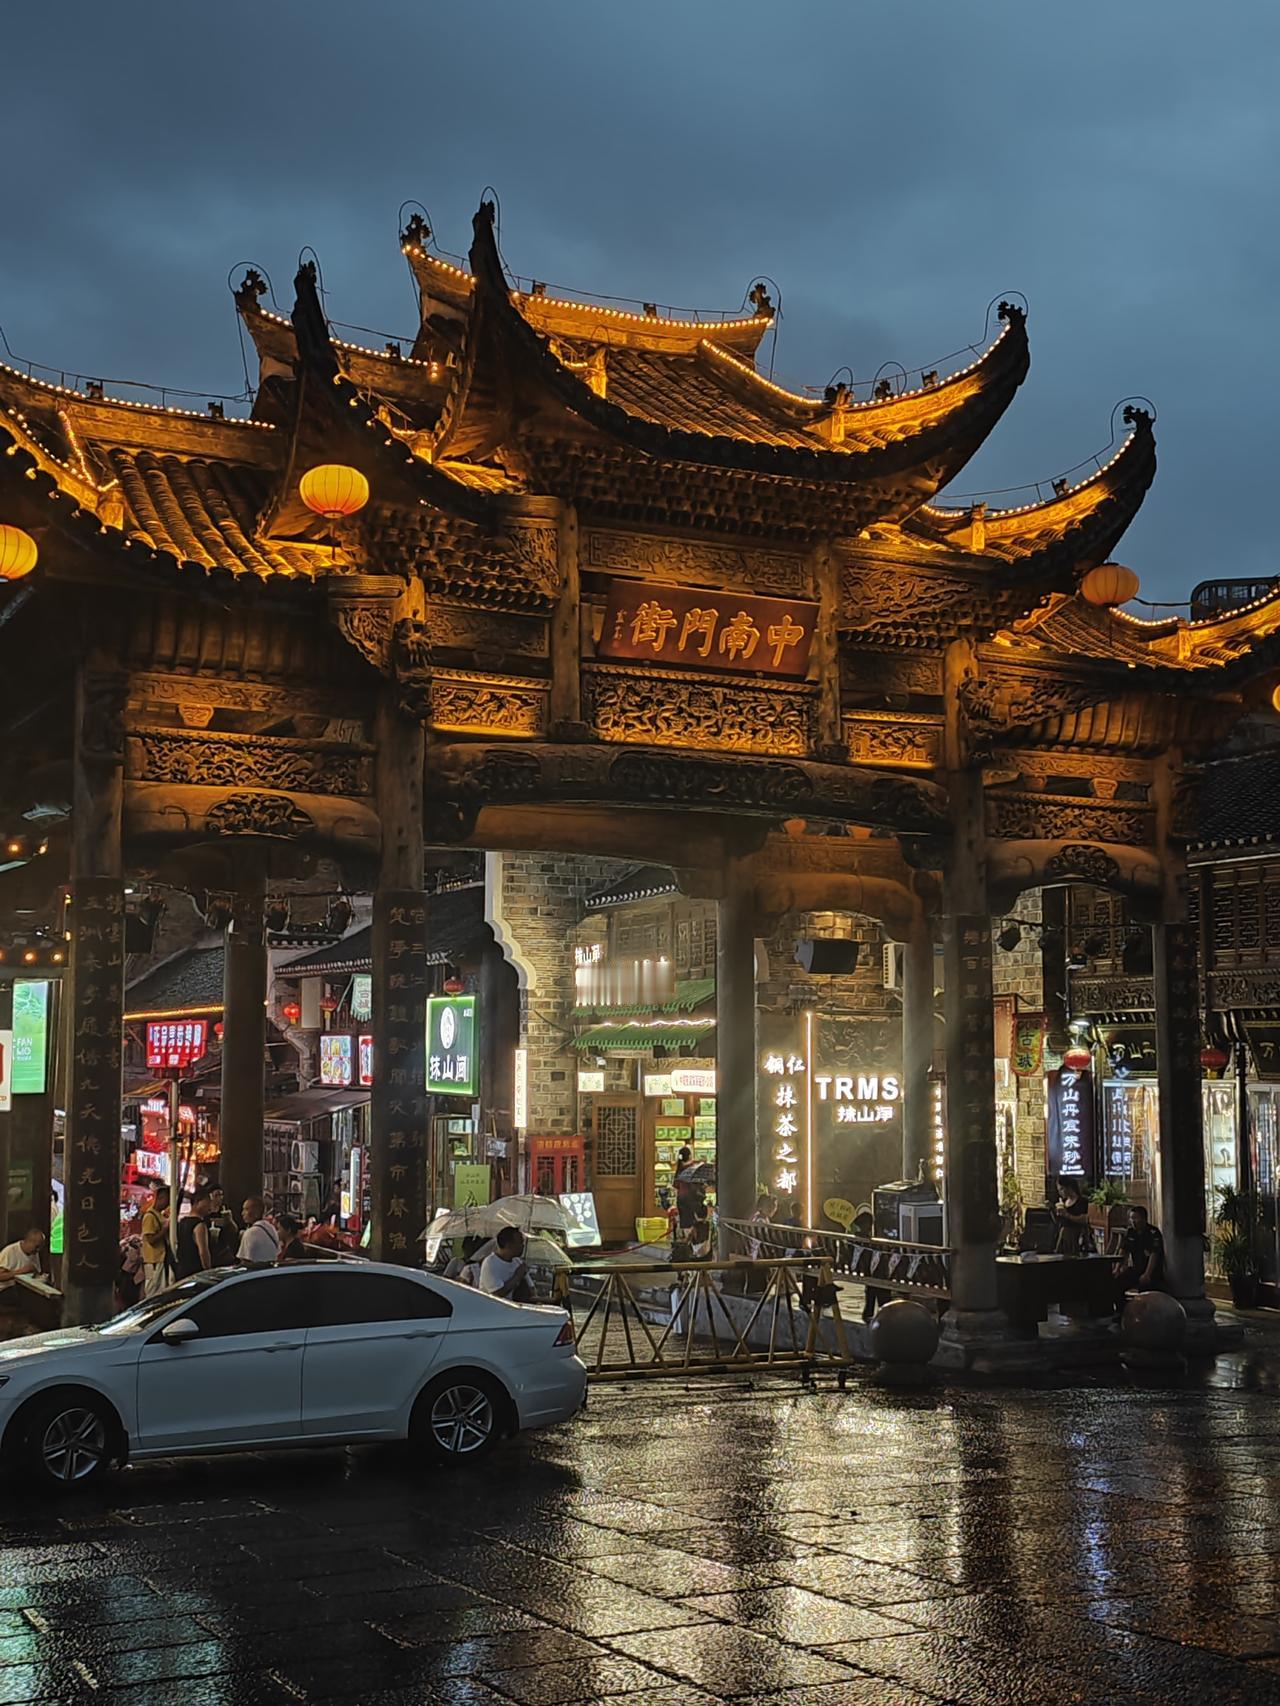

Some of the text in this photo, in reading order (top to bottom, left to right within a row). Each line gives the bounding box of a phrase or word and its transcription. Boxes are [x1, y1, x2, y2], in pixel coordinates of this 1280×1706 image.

[764, 1055, 806, 1075] 铜仁
[814, 1076, 899, 1101] TRMS
[776, 1085, 798, 1195] 抹茶之都
